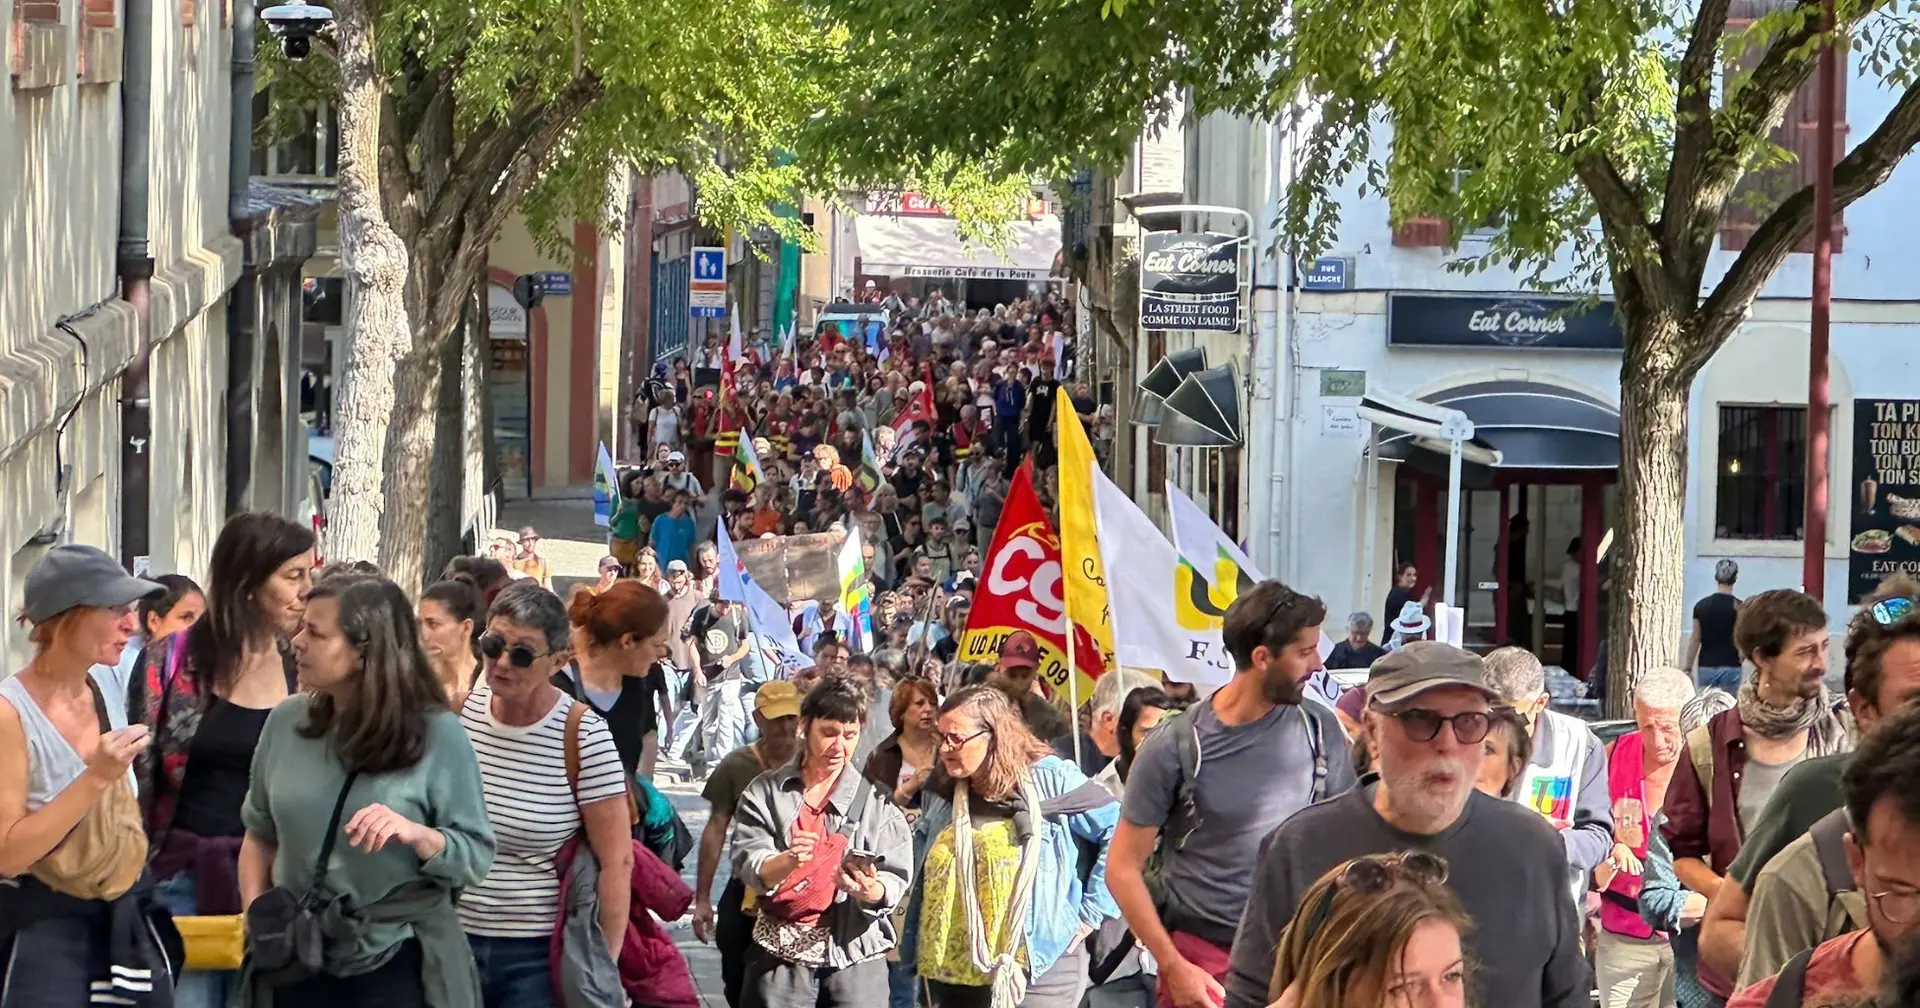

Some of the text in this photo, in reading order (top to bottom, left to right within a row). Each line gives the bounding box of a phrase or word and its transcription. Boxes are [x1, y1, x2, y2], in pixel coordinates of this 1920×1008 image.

[1144, 251, 1236, 274] Eat Corner
[1320, 264, 1336, 273] RUE
[904, 267, 951, 277] Brasserie
[980, 268, 992, 278] de
[996, 269, 1005, 278] la
[1009, 269, 1036, 279] Poste
[1308, 274, 1341, 283] BLANCHE
[1148, 303, 1230, 315] LA STREET FOOD
[1142, 314, 1180, 325] COMME
[1181, 315, 1196, 325] ON
[1468, 310, 1566, 334] Eat Corner
[1874, 402, 1898, 422] TA
[1870, 423, 1902, 440] TON
[1869, 439, 1898, 455] TON
[1872, 455, 1902, 470] TON
[1877, 469, 1906, 485] TON
[1872, 560, 1898, 572] EAT
[969, 633, 1070, 688] UD ARE 09
